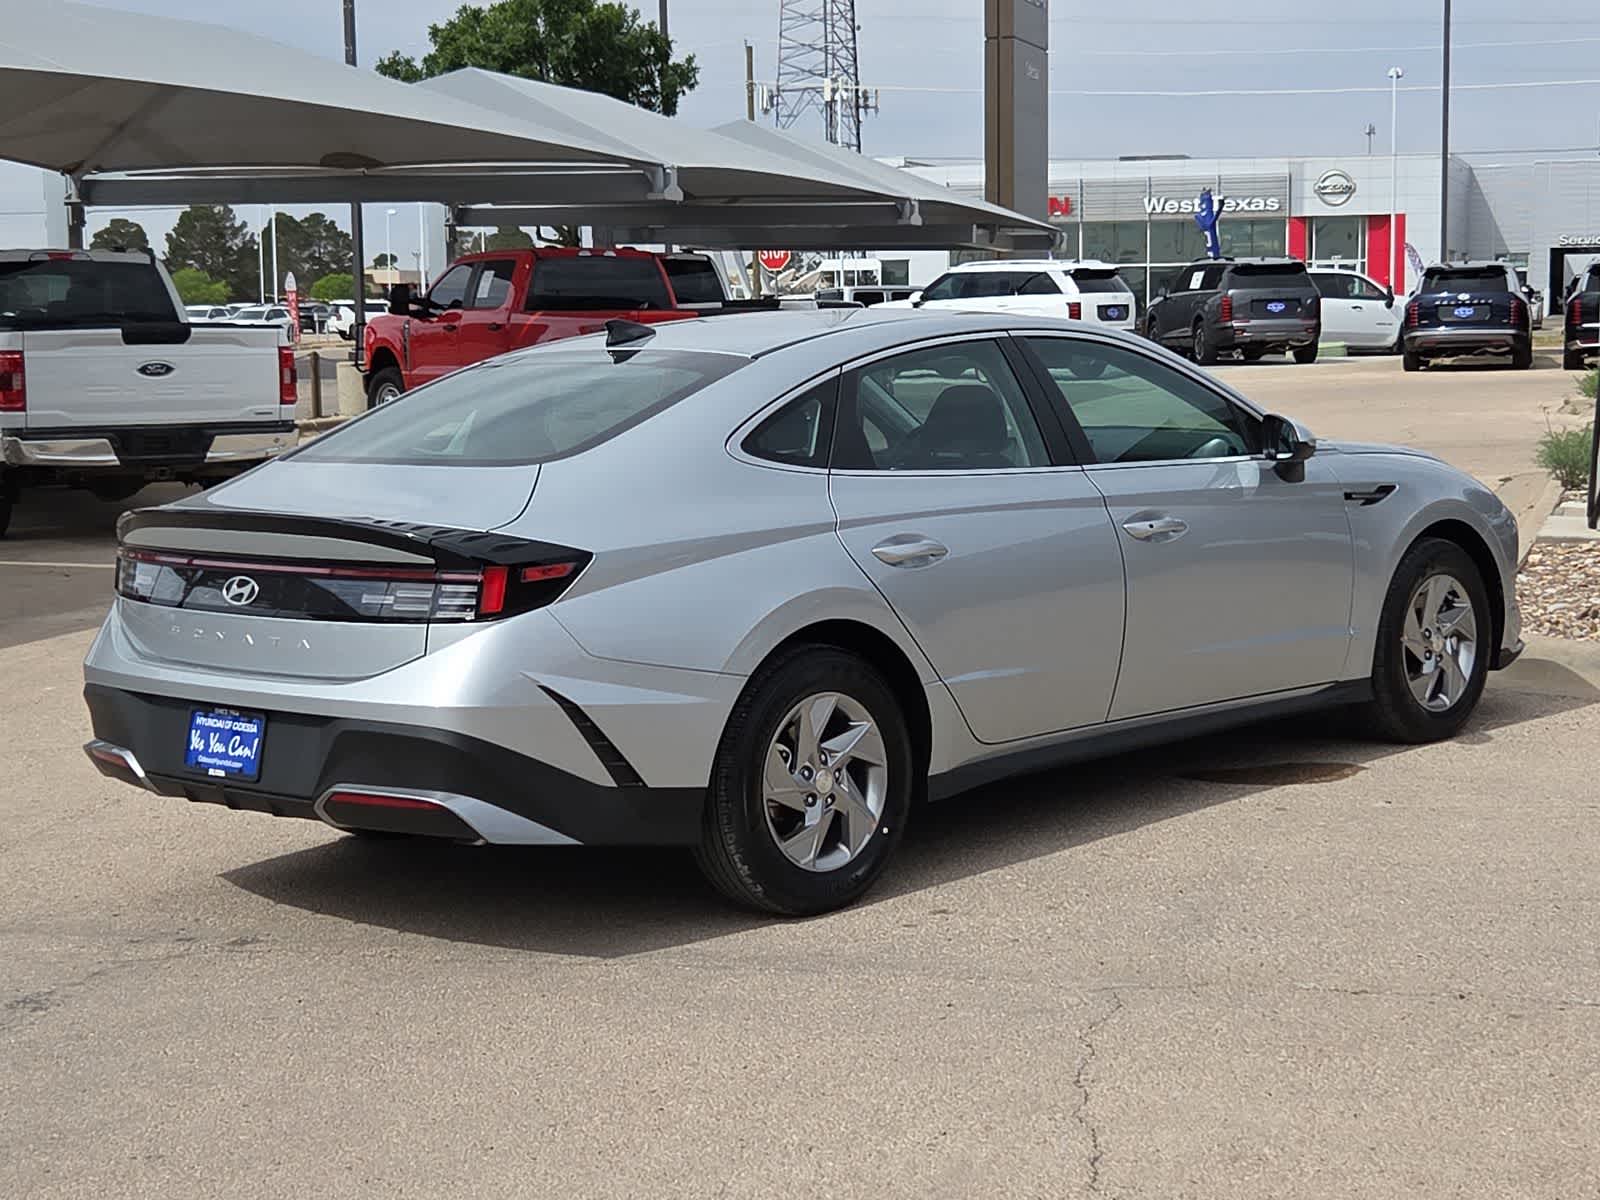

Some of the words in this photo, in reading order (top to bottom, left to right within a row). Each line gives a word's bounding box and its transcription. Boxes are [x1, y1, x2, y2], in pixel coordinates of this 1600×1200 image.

[1143, 196, 1202, 214] West
[1212, 195, 1280, 212] Texas
[760, 249, 788, 260] STOP
[170, 624, 311, 649] SONATA
[196, 716, 225, 729] HYUNDAI
[224, 719, 233, 730] OF
[232, 721, 258, 733] ODESSA
[190, 729, 205, 751] Yes
[208, 732, 226, 753] You
[228, 735, 260, 760] Can!
